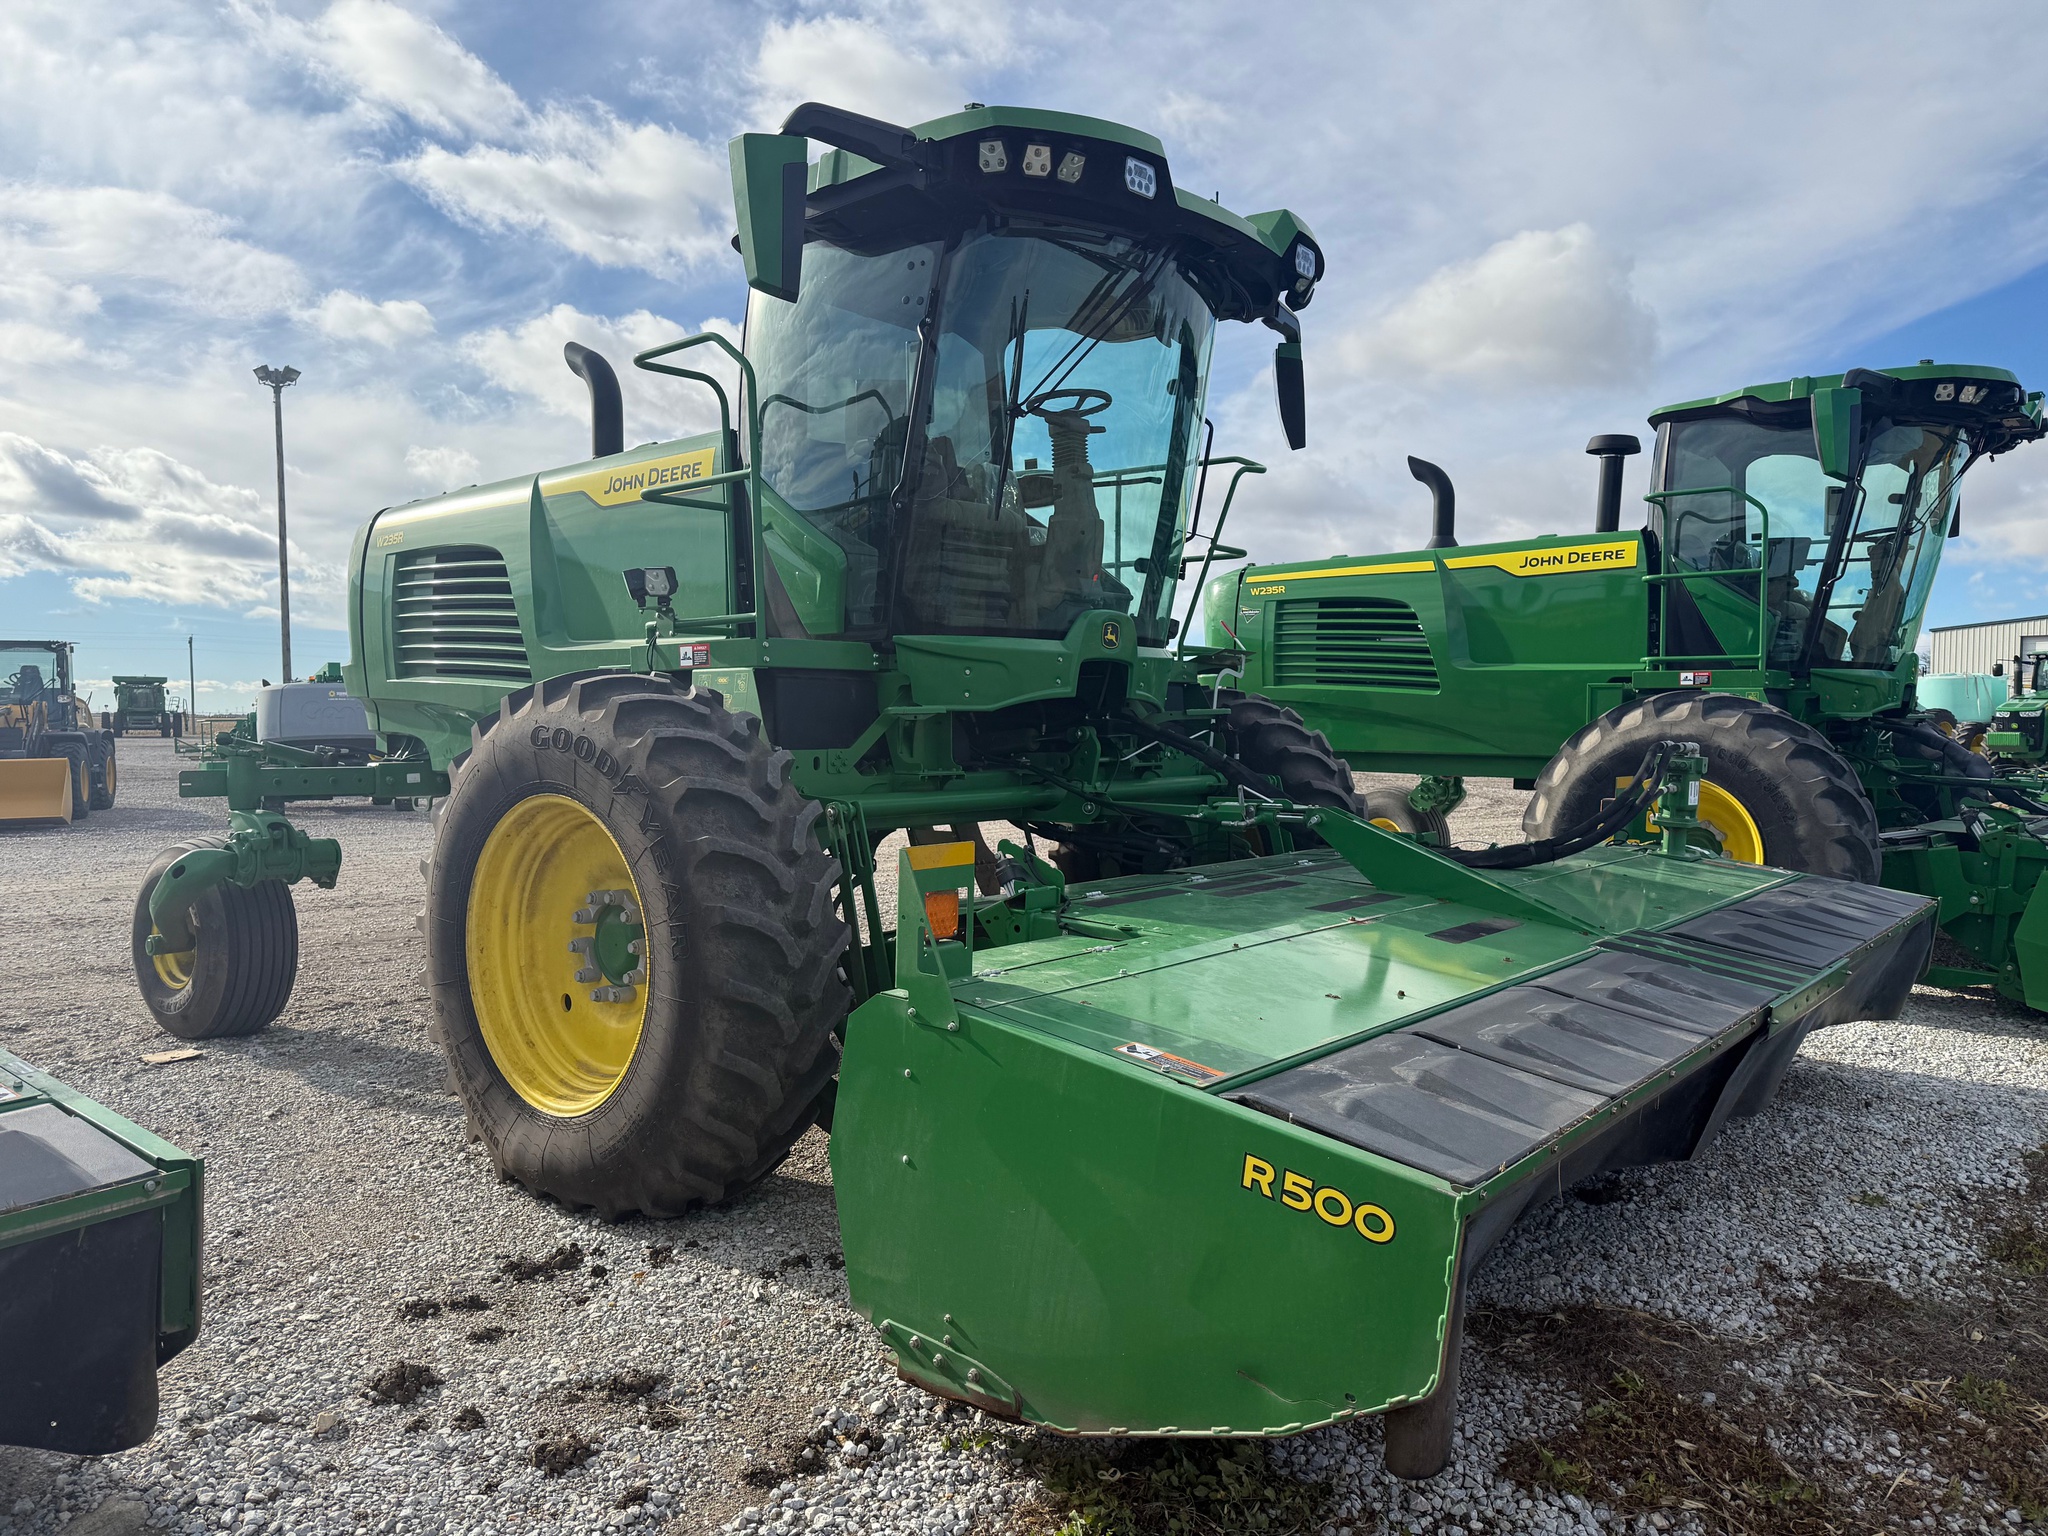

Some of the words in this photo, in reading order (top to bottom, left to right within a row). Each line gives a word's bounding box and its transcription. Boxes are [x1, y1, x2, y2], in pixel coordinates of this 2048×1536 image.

[603, 472, 645, 495] JOHN
[647, 461, 703, 486] DEERE
[376, 531, 404, 548] W235R
[1519, 554, 1564, 569] JOHN
[1567, 549, 1626, 564] DEERE
[1250, 585, 1286, 596] W235R
